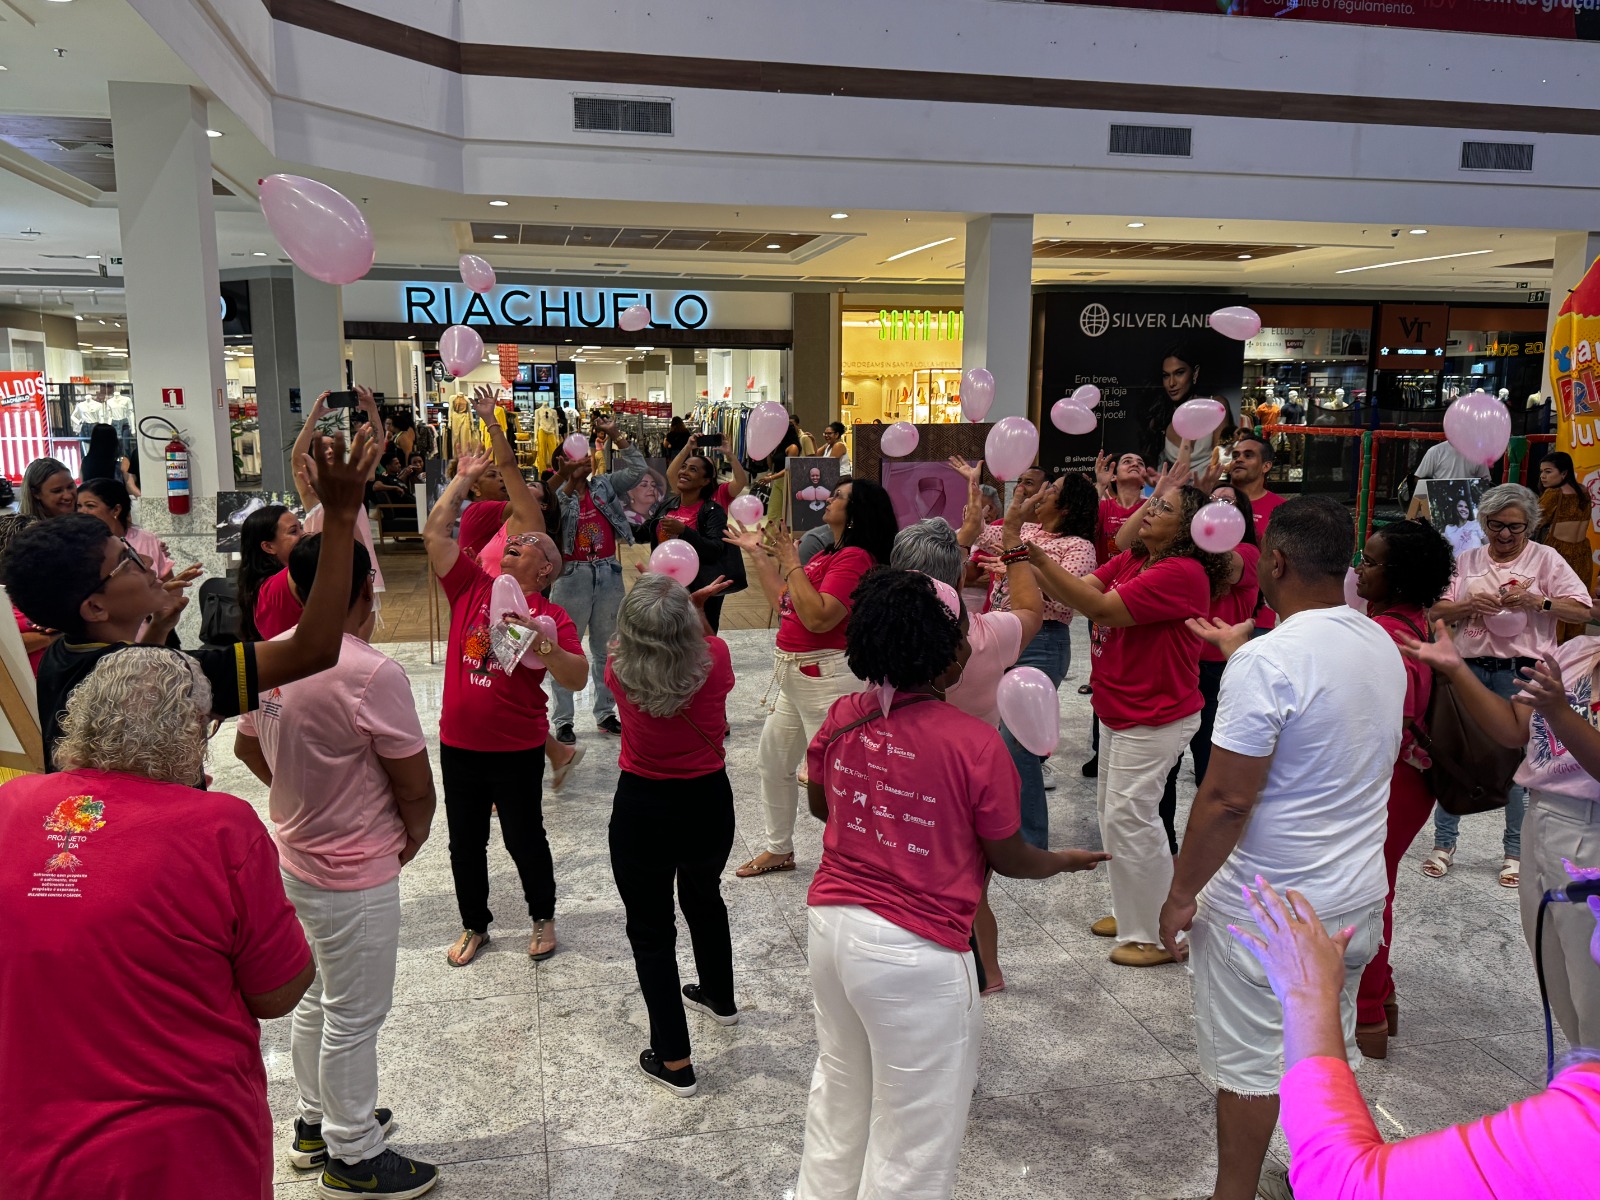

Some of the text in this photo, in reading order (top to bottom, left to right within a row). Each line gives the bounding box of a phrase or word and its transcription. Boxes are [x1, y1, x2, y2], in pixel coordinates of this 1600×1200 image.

[1333, 0, 1415, 15] regulamento.
[405, 286, 708, 328] RIACHUELO
[879, 310, 931, 341] SANTA
[1111, 313, 1168, 328] SILVER
[1399, 317, 1431, 342] VT
[1075, 374, 1119, 385] Em breve,
[1111, 387, 1127, 397] loja
[1104, 411, 1126, 419] você!
[470, 673, 492, 688] Vida
[922, 794, 936, 804] VISA
[882, 839, 897, 848] VALE
